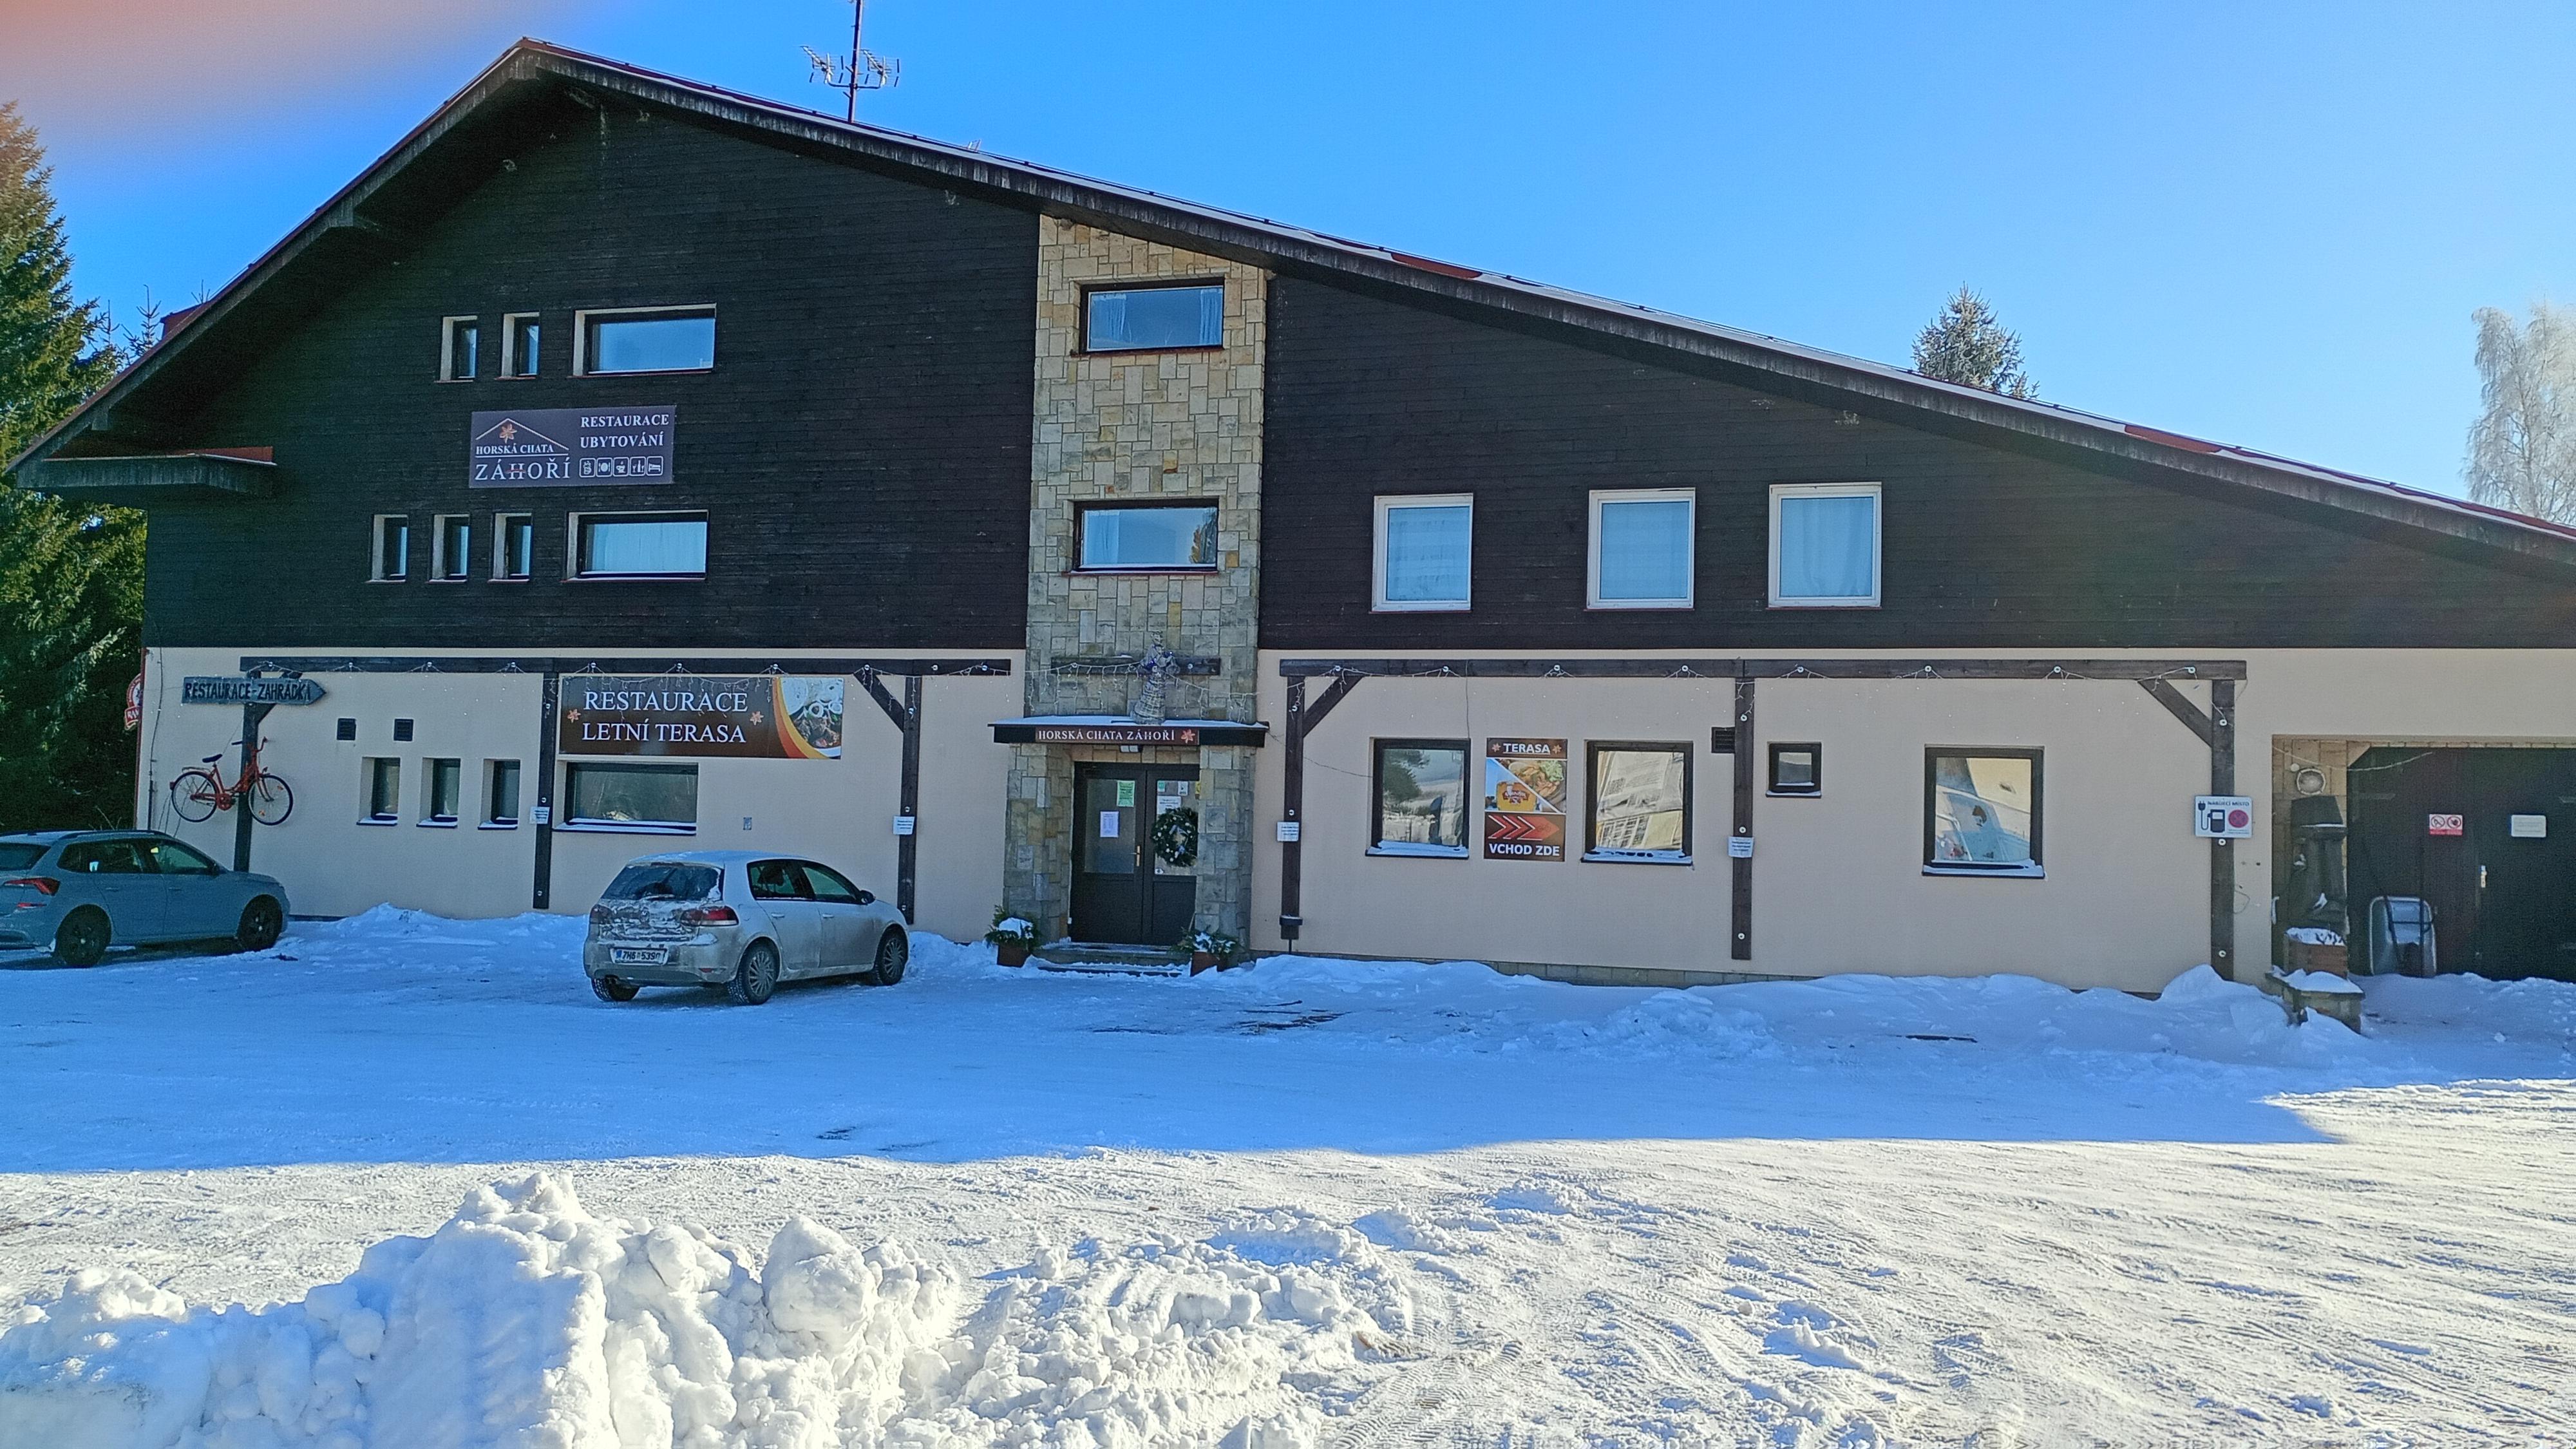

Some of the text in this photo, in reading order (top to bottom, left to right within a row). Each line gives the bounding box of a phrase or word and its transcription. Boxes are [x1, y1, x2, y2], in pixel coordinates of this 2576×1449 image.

[580, 414, 669, 428] RESTAURACE
[580, 431, 664, 448] UBYTOVÁNÍ
[476, 443, 554, 455] HORSKÁ CHATA
[475, 457, 571, 480] ZÁHOŘÍ
[583, 692, 748, 712] RESTAURACE
[582, 719, 746, 743] LETNÍ TERASA
[1038, 729, 1175, 741] HORSKÁ CHATA ZÁHOŘÍ
[1503, 743, 1551, 753] TERASA
[1489, 844, 1560, 857] VCHOD ZDE
